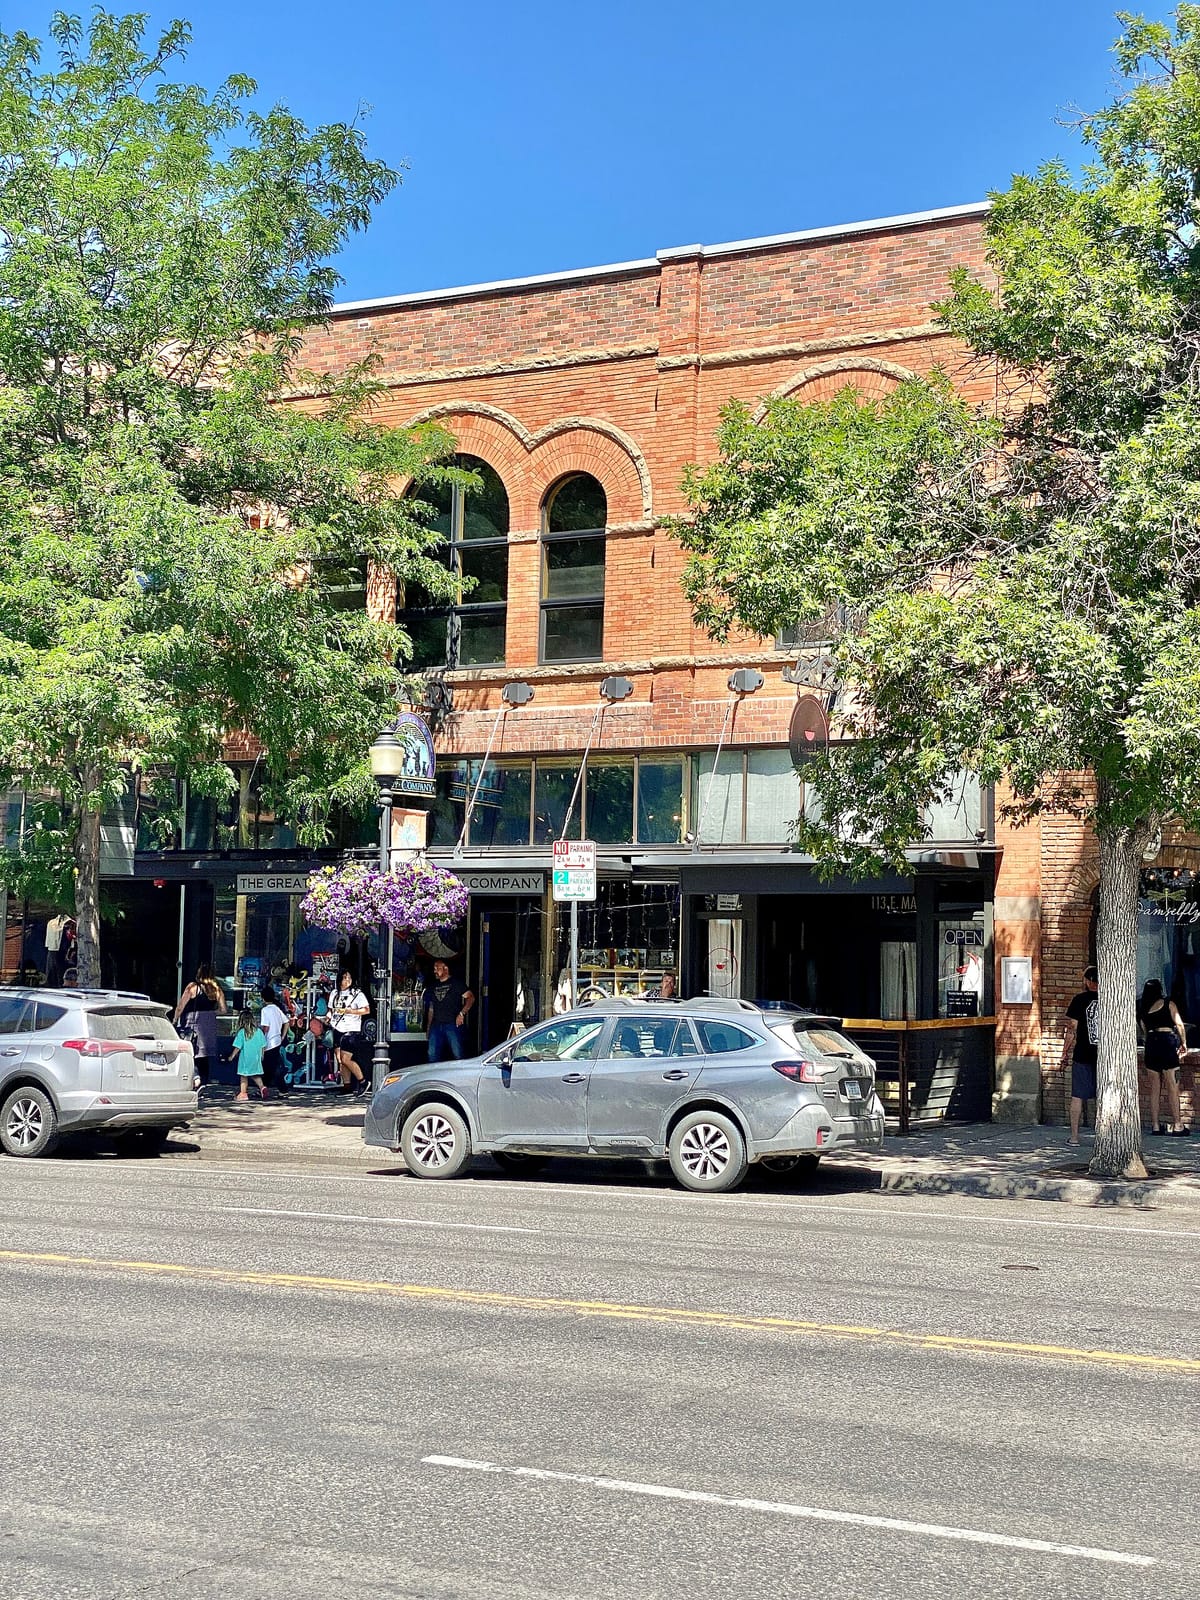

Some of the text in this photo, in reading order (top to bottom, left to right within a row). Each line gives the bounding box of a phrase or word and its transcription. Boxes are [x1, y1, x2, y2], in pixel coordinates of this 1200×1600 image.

[556, 842, 567, 853] NO
[240, 878, 264, 889] THE
[267, 878, 308, 889] GREAT
[470, 877, 541, 889] COMPANY
[557, 872, 566, 884] 2
[945, 929, 983, 945] OPEN
